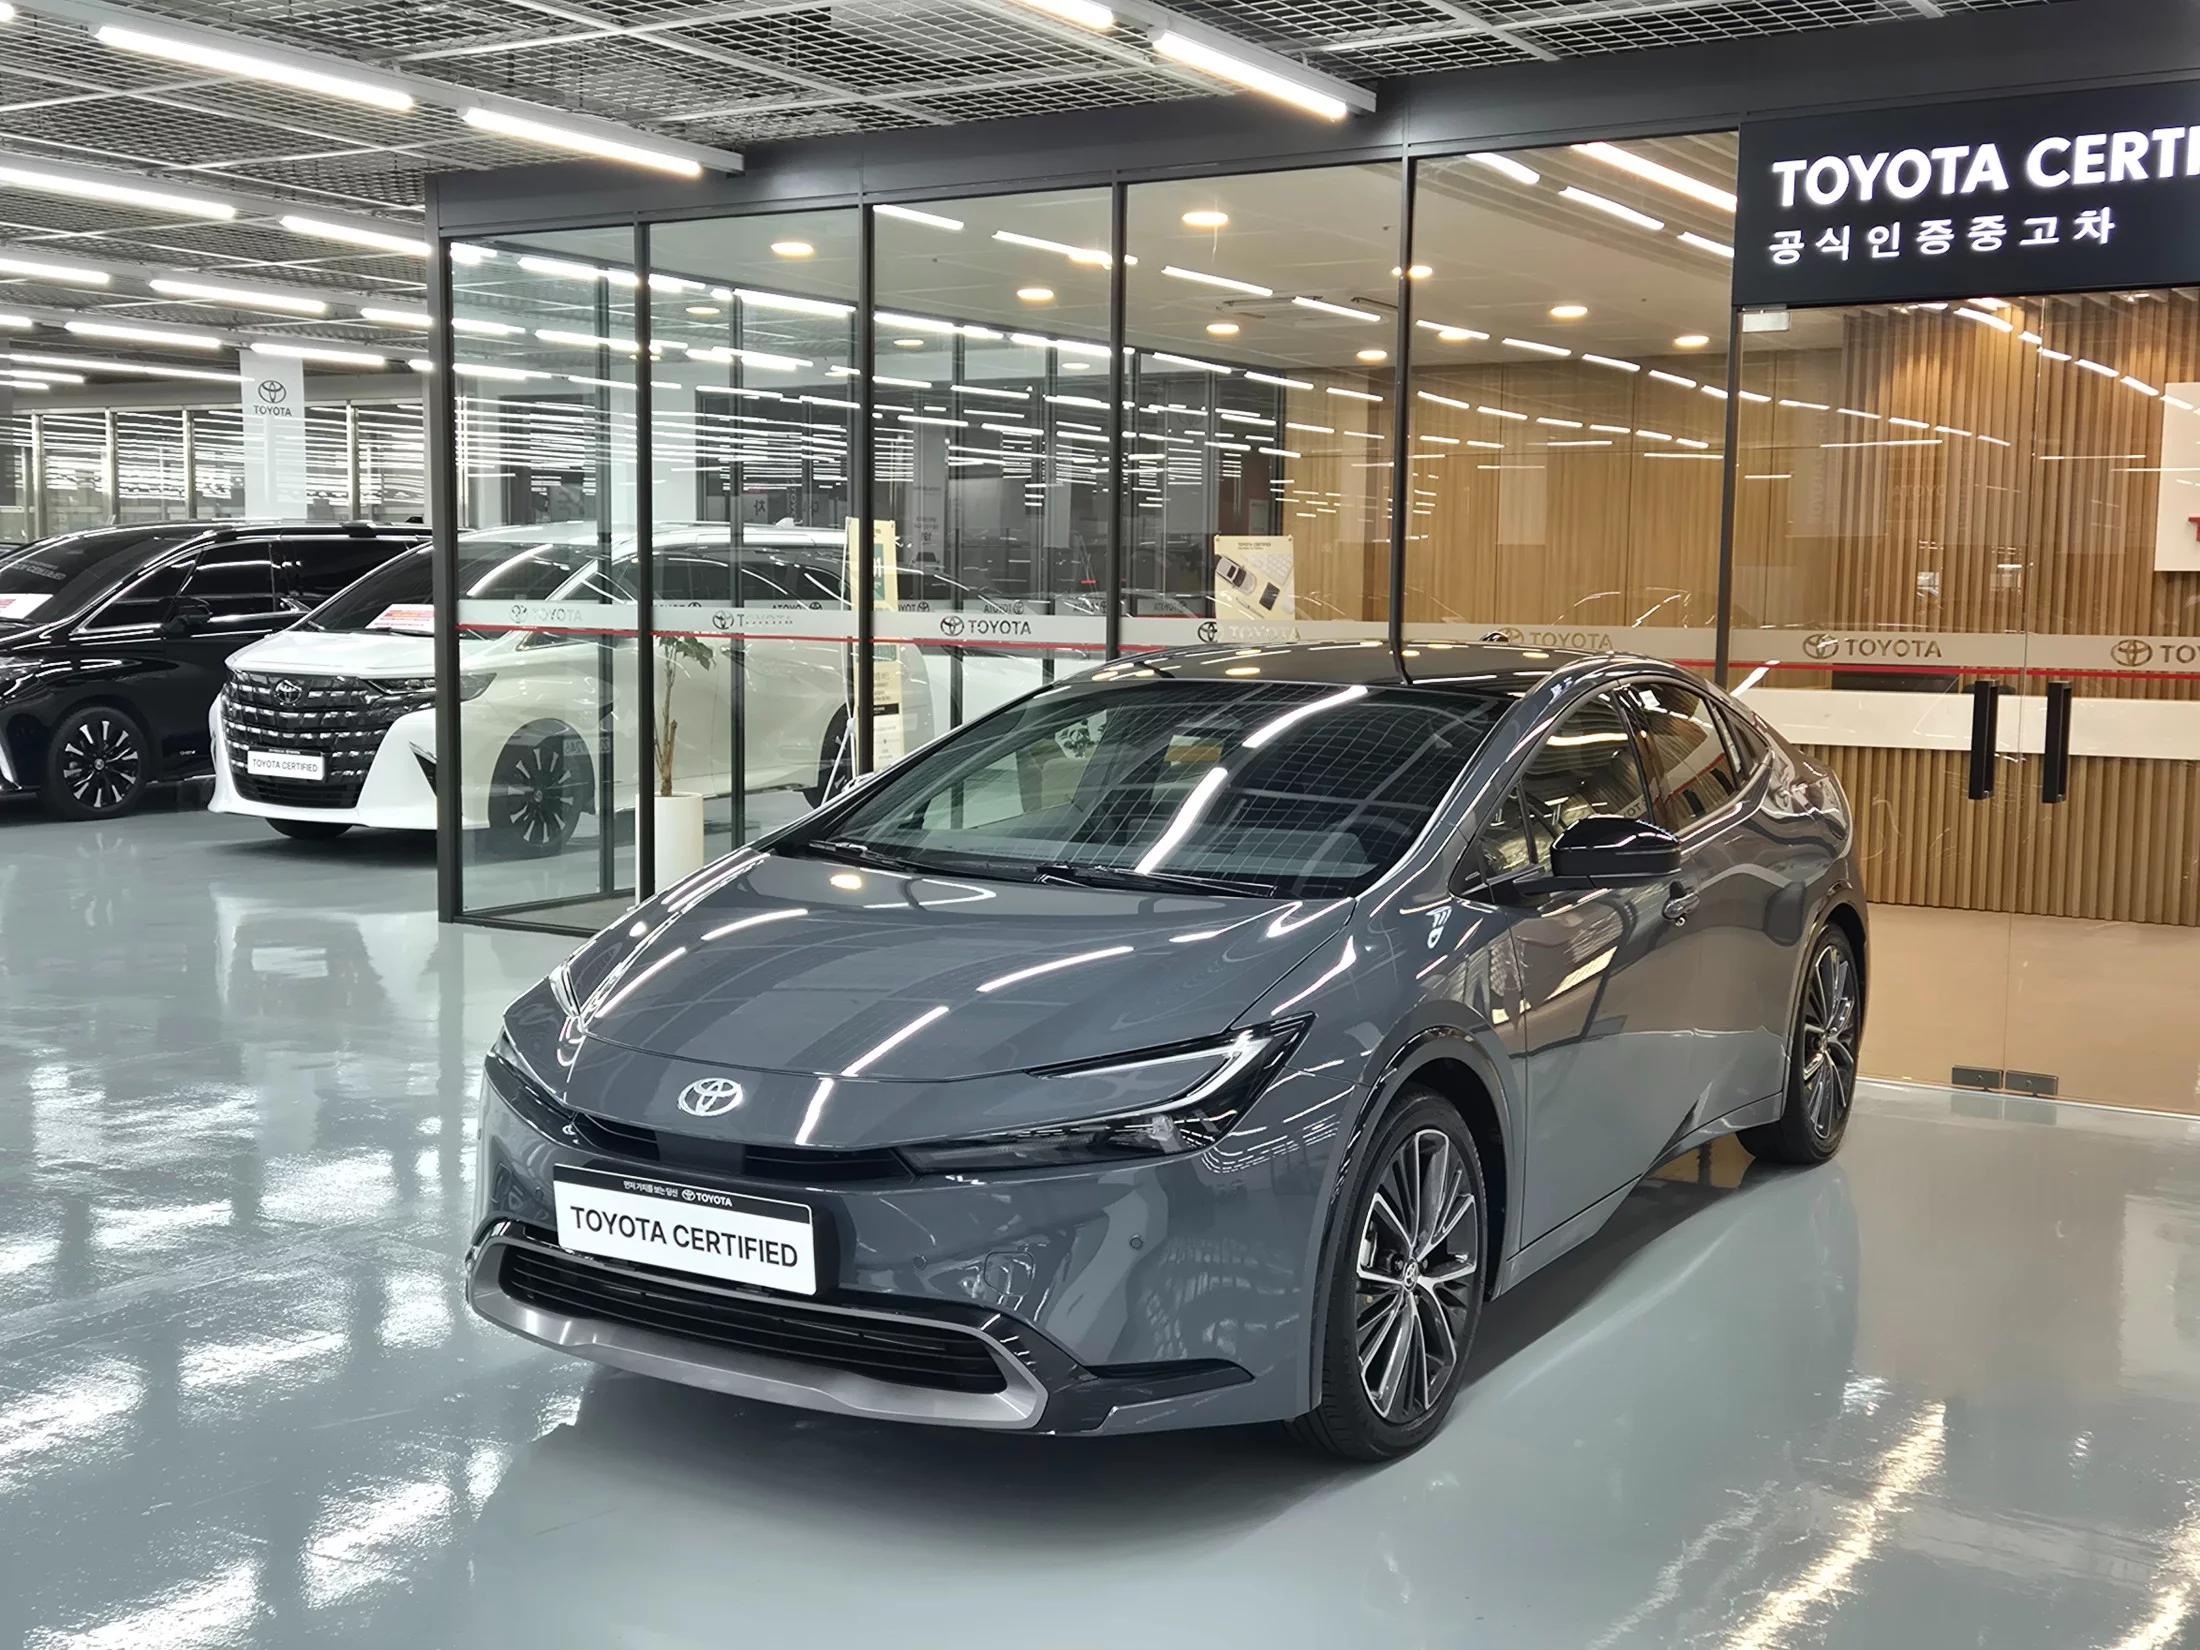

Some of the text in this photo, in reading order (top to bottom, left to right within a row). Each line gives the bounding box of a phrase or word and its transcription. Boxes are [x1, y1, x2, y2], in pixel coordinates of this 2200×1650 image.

[1772, 143, 2009, 208] TOYOTA
[253, 405, 292, 417] TOYOTA
[968, 619, 1032, 635] TOYOTA
[1529, 631, 1614, 651] TOYOTA
[1845, 638, 1942, 658] TOYOTA
[2160, 643, 2200, 664] TO
[253, 758, 318, 773] TOYOTA CERTIFIED
[696, 1192, 733, 1207] TOYOTA
[570, 1206, 798, 1268] TOYOTA CERTIFIED
